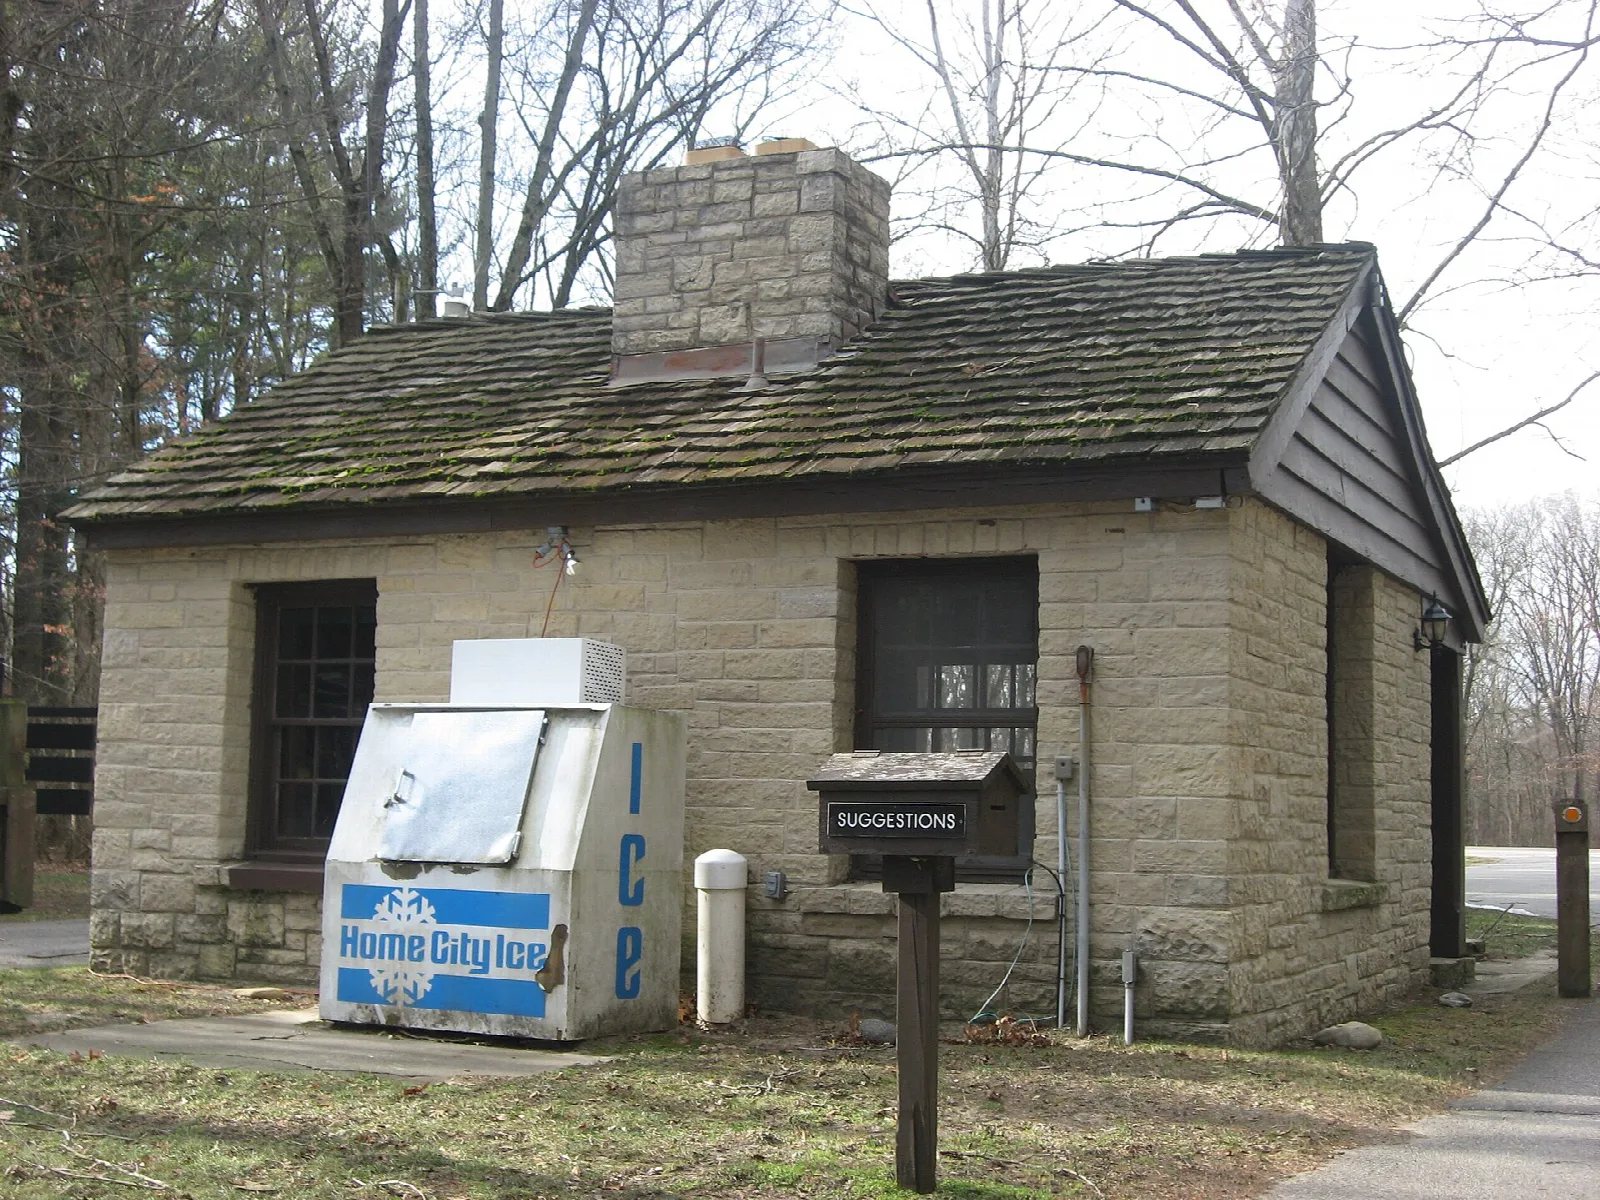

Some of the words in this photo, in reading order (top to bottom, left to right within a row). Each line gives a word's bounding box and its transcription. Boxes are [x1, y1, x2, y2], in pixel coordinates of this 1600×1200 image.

[837, 811, 956, 830] SUGGESTIONS
[615, 742, 646, 1000] Ice
[340, 924, 425, 962] Home
[431, 930, 491, 975] City
[496, 933, 547, 970] Ice
